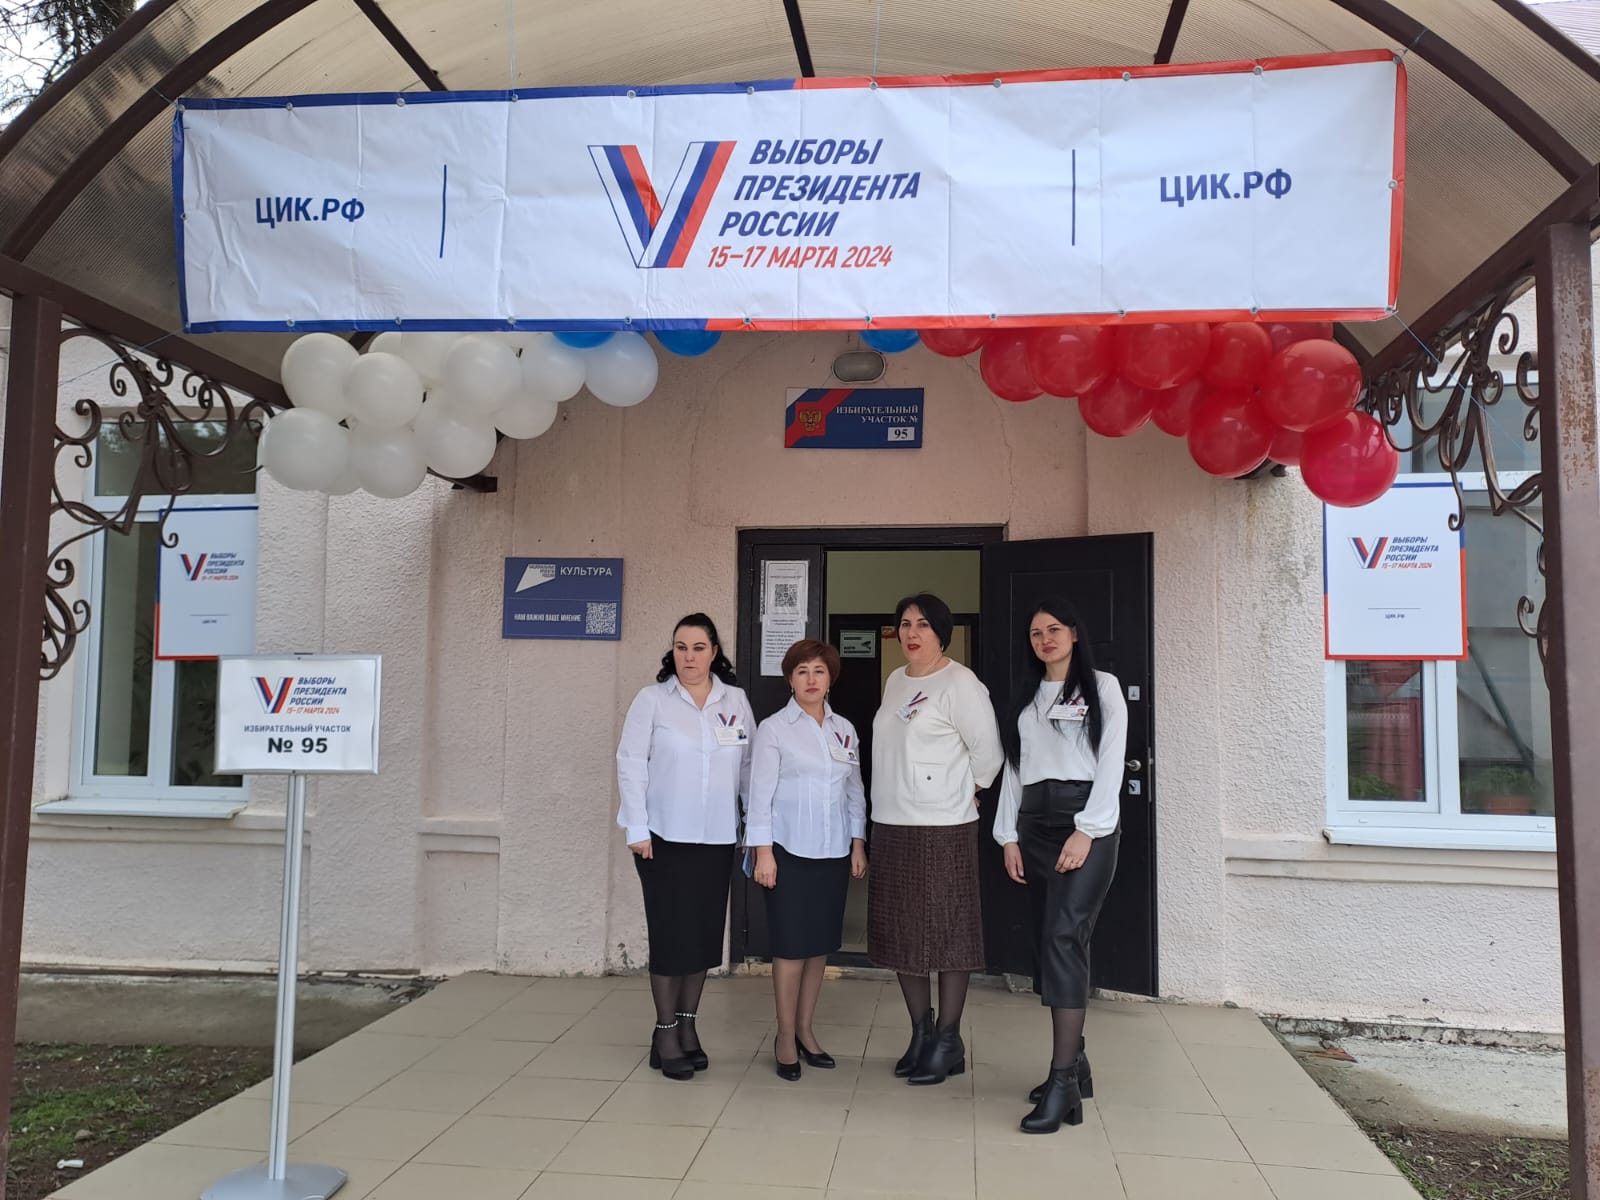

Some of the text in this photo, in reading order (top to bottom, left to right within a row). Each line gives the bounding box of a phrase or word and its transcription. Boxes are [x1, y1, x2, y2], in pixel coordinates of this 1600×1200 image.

[748, 138, 884, 165] ВЫБОРЫ
[733, 171, 921, 205] ПРЕЗИДЕНТА
[1160, 168, 1292, 207] ЦИК.РФ
[255, 197, 365, 229] ЦИК.РФ
[718, 211, 839, 237] РОССИИ
[766, 246, 839, 268] МАРТА
[840, 245, 893, 268] 2024
[836, 404, 919, 414] ИЗБИРАТЕЛЬНЫЙ
[894, 429, 908, 439] 95
[1392, 536, 1429, 544] ВЫБОРЫ
[1388, 545, 1440, 553] ПРЕЗИДЕНТА
[1384, 554, 1418, 562] РОССИИ
[560, 566, 612, 576] КУЛЬТУРА
[297, 677, 336, 685] ВЫБОРЫ
[293, 687, 347, 696] ПРЕЗИДЕНТА
[289, 697, 324, 705] РОССИИ
[244, 723, 351, 733] ИЗБИРАТЕЛЬНЫЙ УЧАСТОК
[268, 737, 328, 753] № 95
